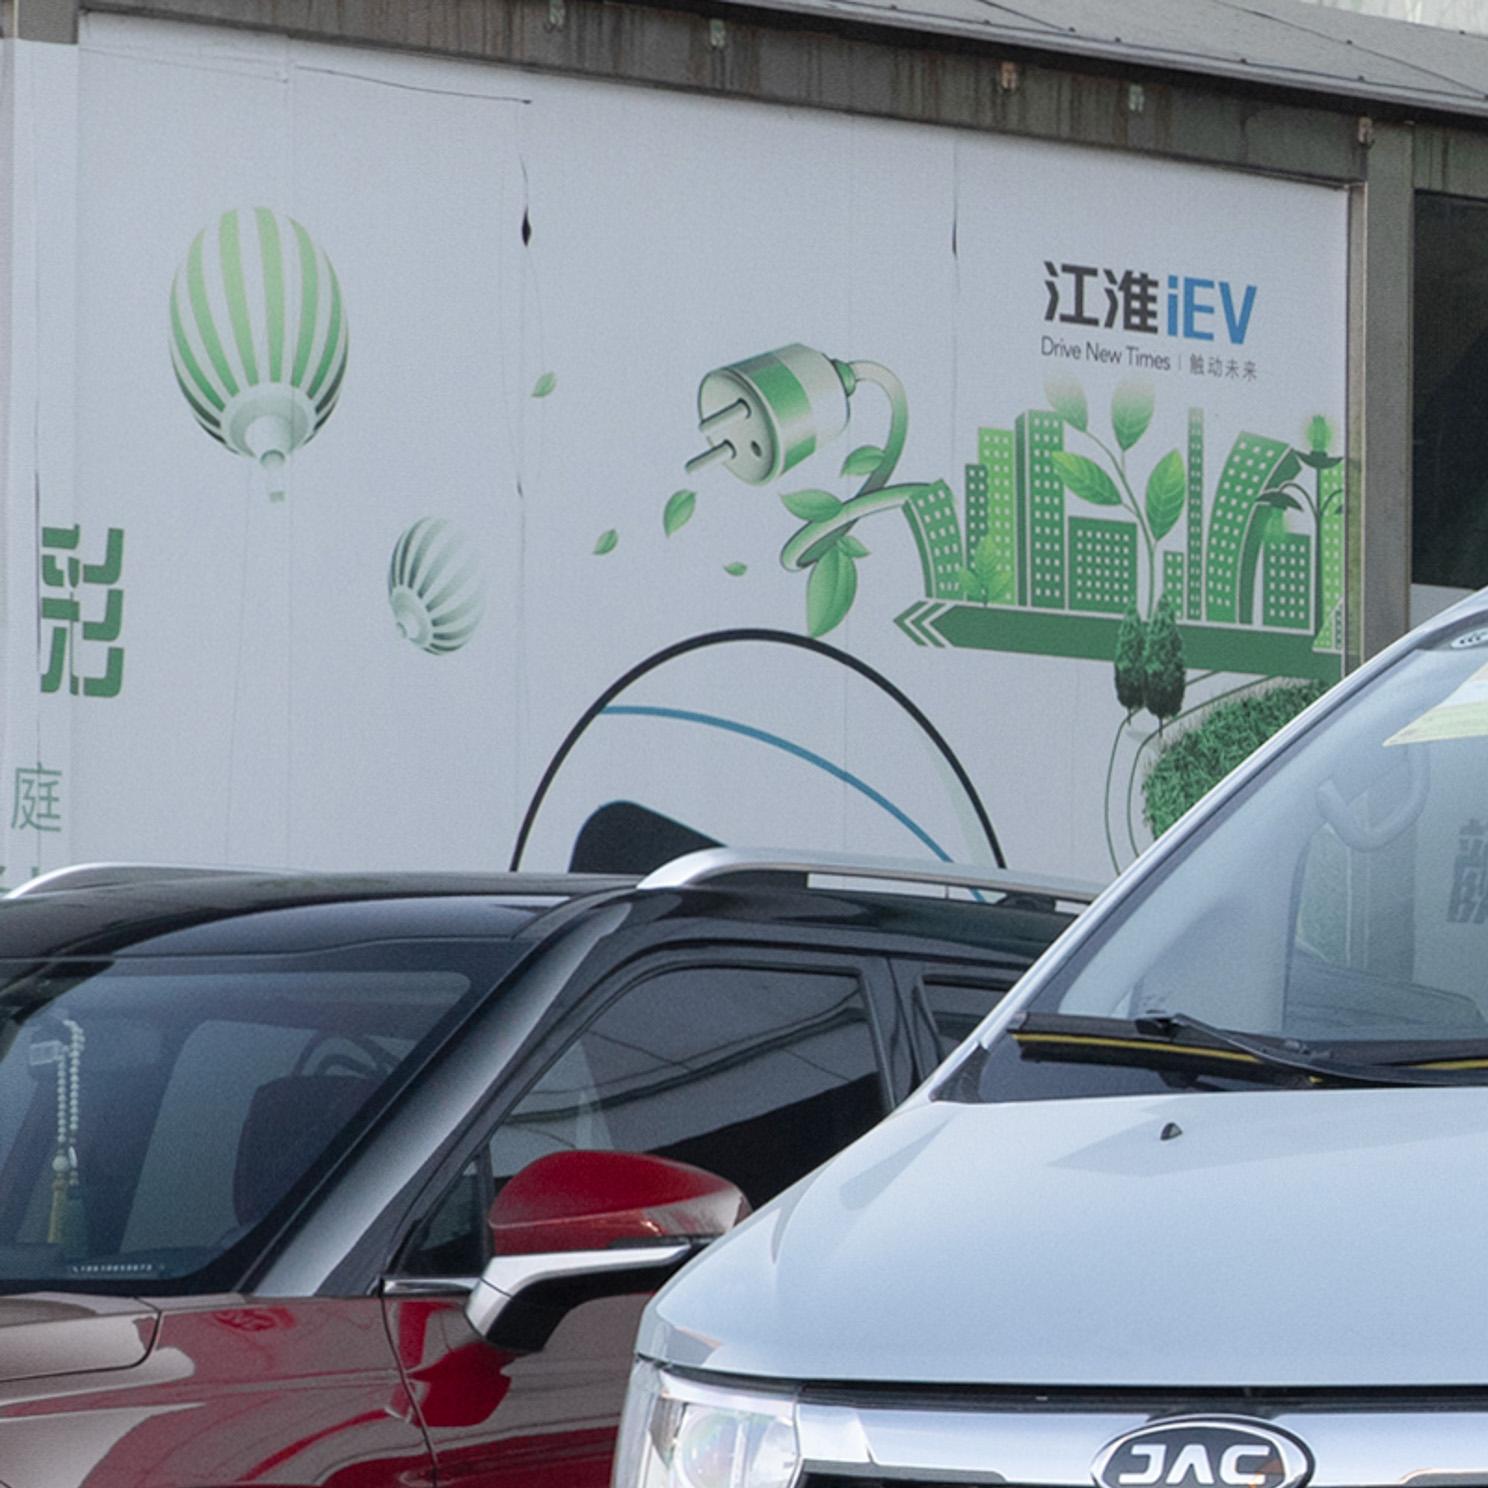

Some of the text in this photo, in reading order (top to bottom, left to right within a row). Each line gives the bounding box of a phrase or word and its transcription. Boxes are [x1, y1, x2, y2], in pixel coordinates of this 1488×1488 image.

[1043, 260, 1258, 346] 江淮iEV
[1040, 335, 1082, 361] Drive
[1085, 341, 1122, 365] New
[1126, 345, 1171, 371] Times
[11, 761, 63, 833] 庭
[1118, 1444, 1271, 1486] JAC
